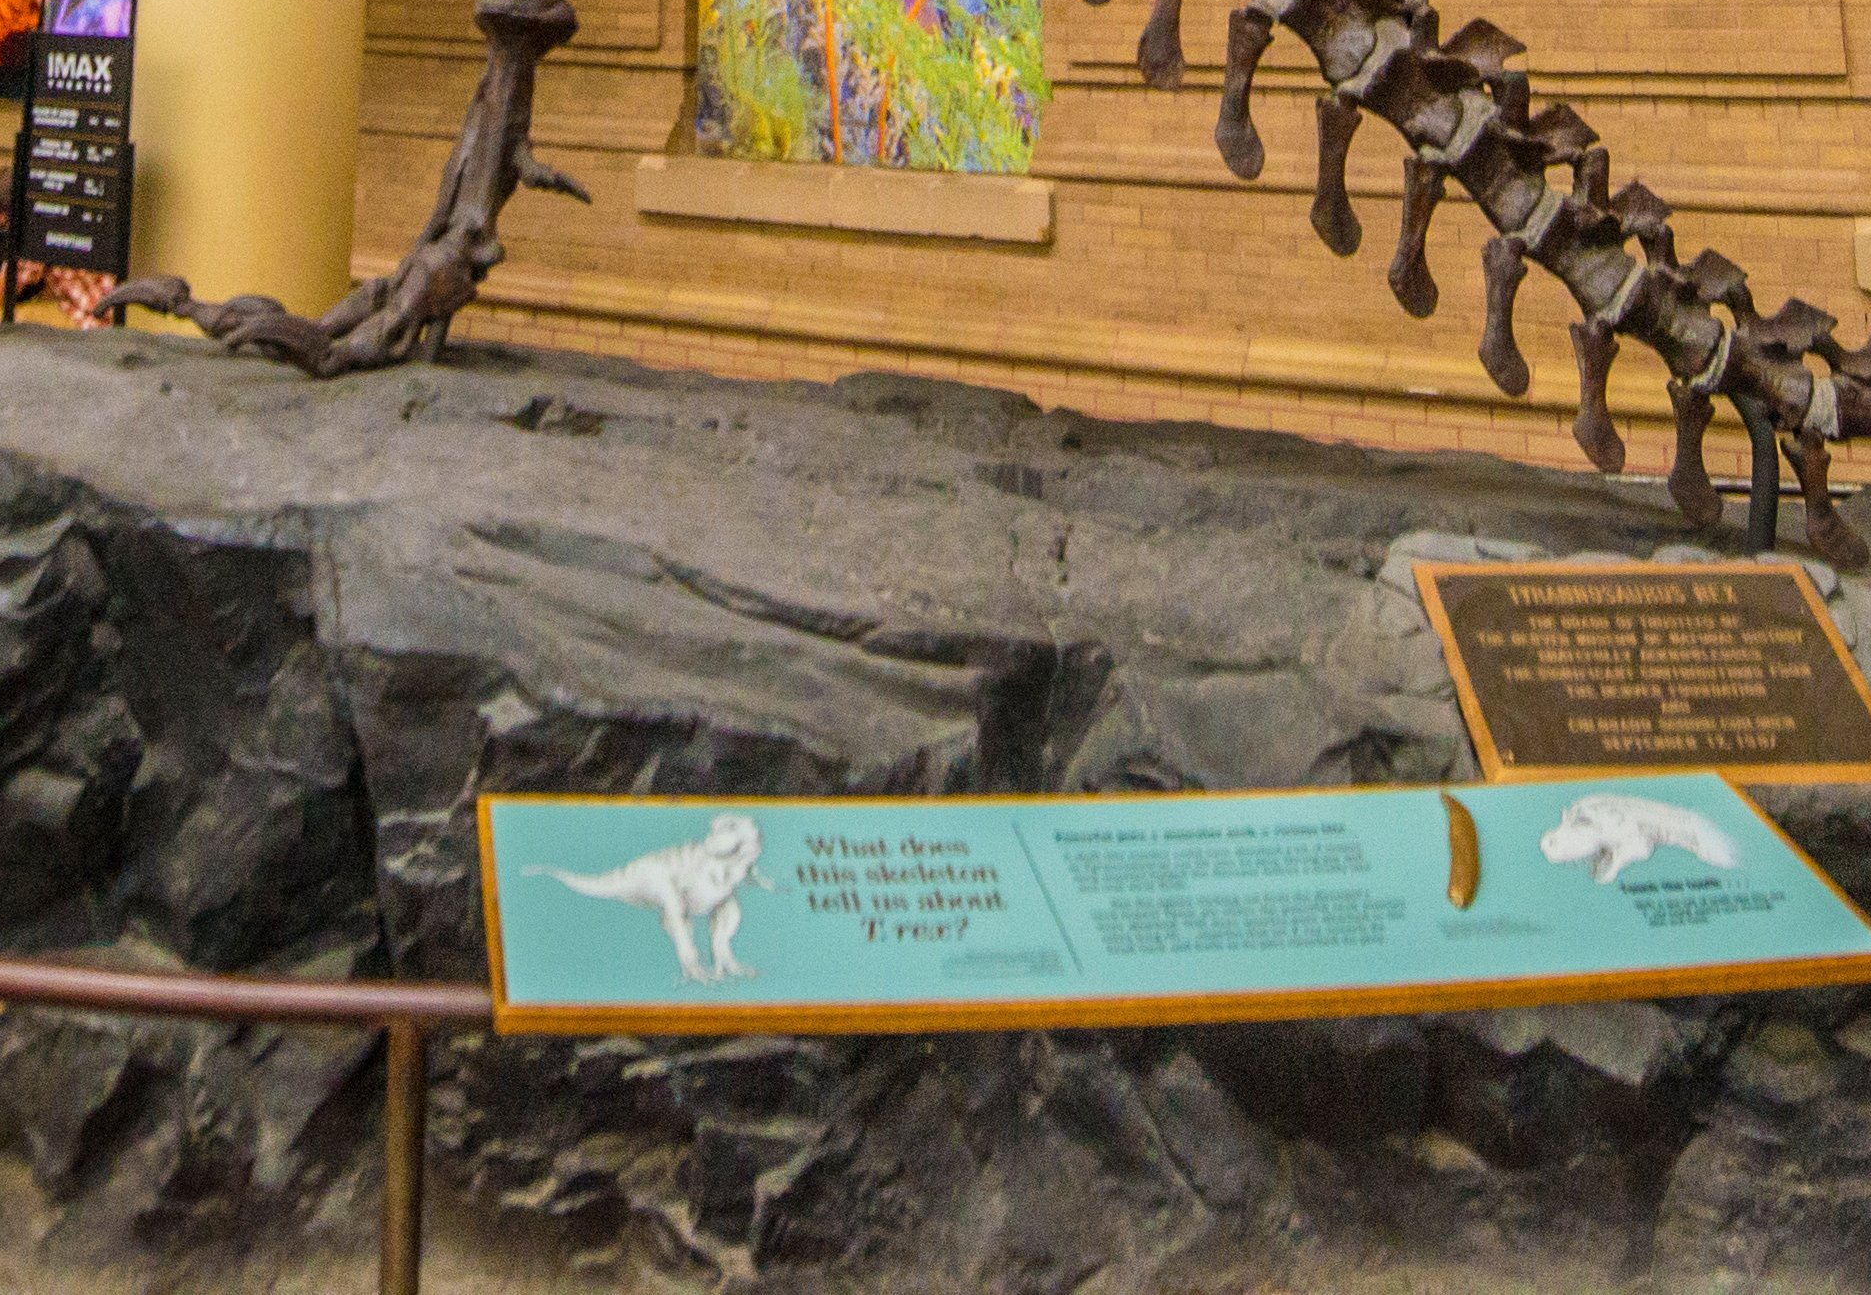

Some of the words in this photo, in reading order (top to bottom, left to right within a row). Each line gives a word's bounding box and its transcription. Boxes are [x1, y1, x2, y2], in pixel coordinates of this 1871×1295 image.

[47, 51, 112, 82] IMAX
[805, 835, 893, 859] What
[899, 834, 971, 858] does
[797, 862, 859, 887] this
[865, 862, 1000, 886] skeleton
[807, 890, 862, 914] tell
[871, 895, 909, 913] us
[916, 890, 1007, 913] about
[893, 915, 970, 942] rex?
